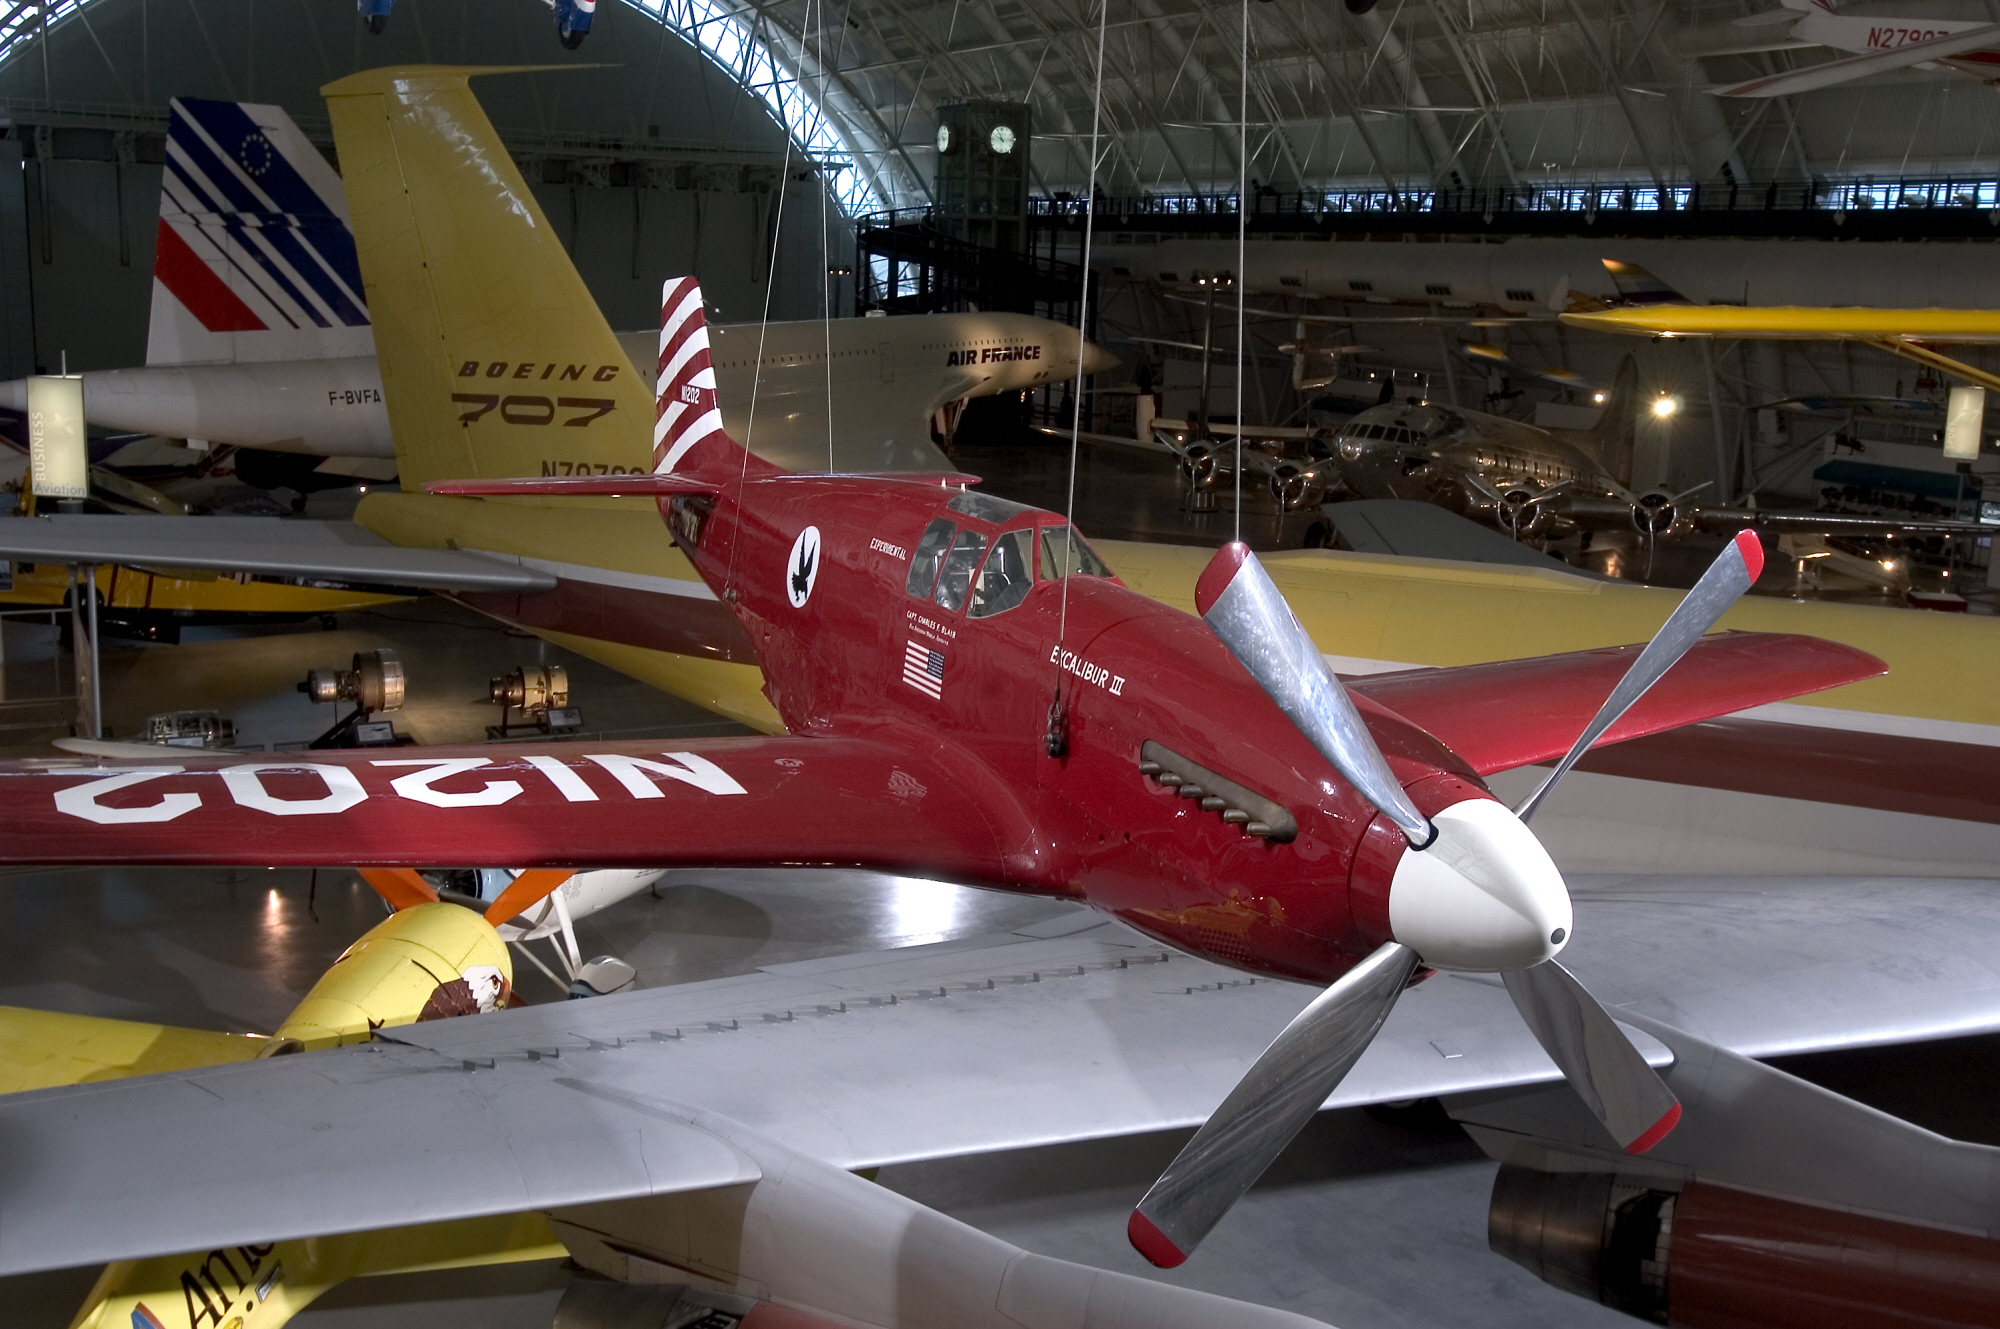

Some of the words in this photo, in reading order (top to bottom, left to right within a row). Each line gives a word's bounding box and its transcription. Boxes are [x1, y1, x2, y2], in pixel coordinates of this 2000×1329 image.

[1867, 27, 1949, 48] N279
[946, 349, 978, 367] AIR
[980, 345, 1041, 364] FRANCE
[457, 360, 620, 382] BOEING
[328, 388, 382, 406] F-BVFA
[681, 384, 700, 405] N1202
[451, 392, 617, 427] 707
[32, 411, 46, 482] BUSINESS
[34, 482, 86, 496] Aviation
[869, 537, 907, 561] EXPERIMENTAL
[918, 615, 936, 630] CHARLES
[941, 625, 957, 639] BLAIR
[1050, 645, 1109, 689] EXCALIBUR
[1108, 674, 1126, 697] III
[47, 751, 749, 824] N1202
